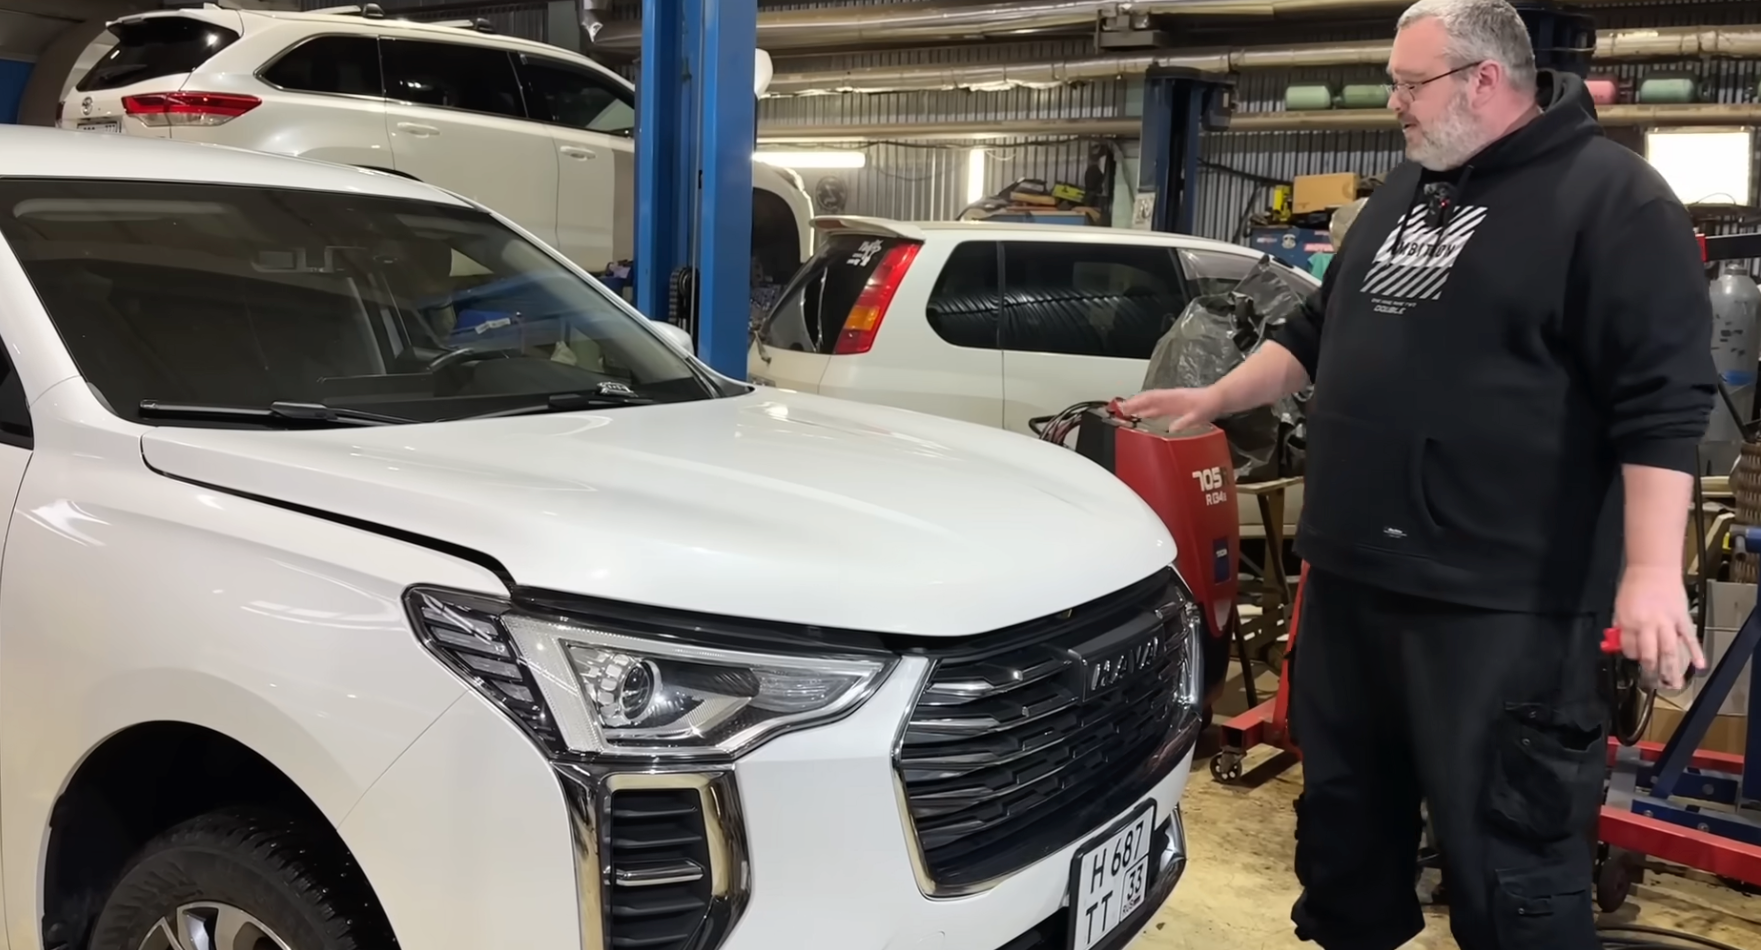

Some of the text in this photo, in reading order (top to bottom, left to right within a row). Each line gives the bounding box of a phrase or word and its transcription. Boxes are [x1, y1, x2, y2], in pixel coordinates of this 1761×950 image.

[1090, 819, 1144, 895] H 687
[1126, 863, 1144, 901] 33
[1085, 890, 1114, 945] TT
